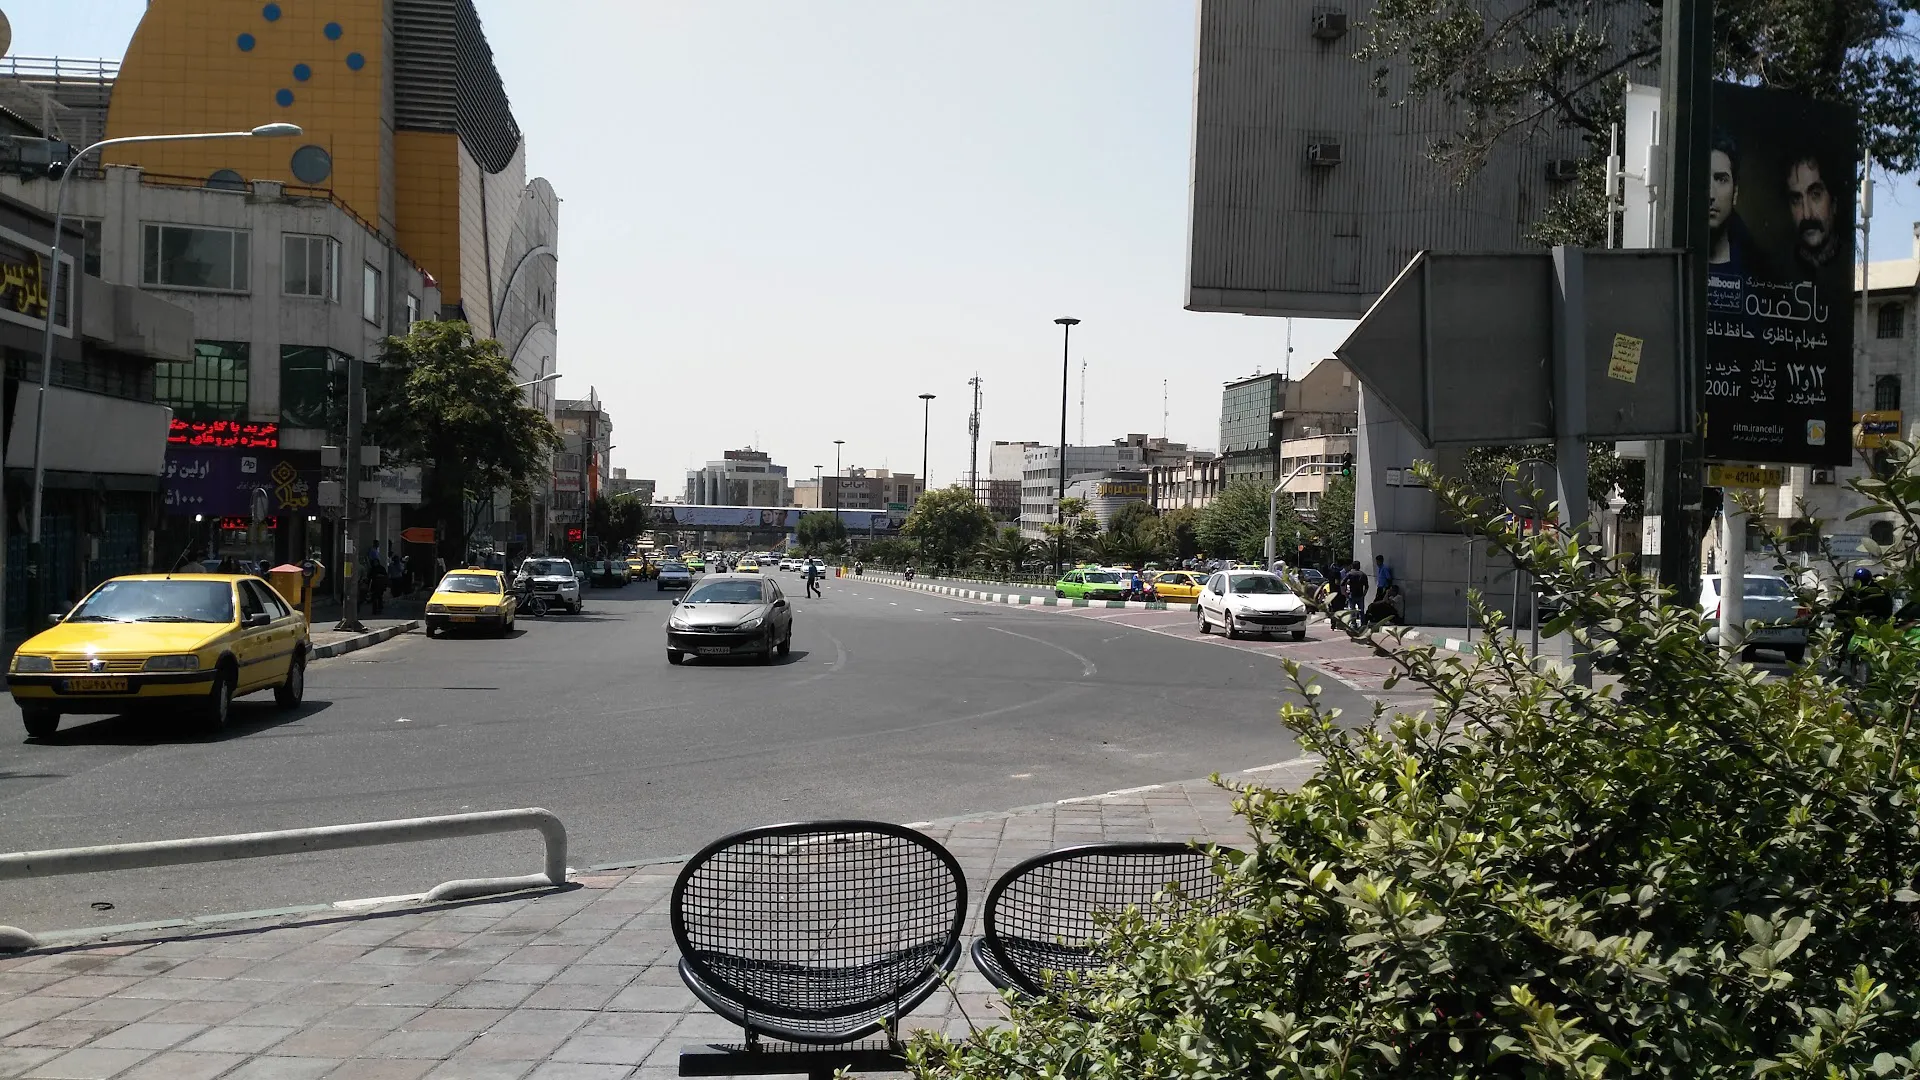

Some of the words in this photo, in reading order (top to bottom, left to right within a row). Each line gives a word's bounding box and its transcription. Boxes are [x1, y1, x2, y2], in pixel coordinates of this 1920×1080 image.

[1745, 275, 1766, 288] بزرگ
[1766, 280, 1794, 290] کنسرت
[1713, 299, 1740, 309] کلاسیک
[1745, 280, 1829, 323] ناگفته
[1724, 321, 1755, 339] حافظ
[1762, 325, 1794, 345] ناظری
[1794, 328, 1828, 351] شهرام
[1715, 359, 1741, 375] خرید
[1750, 358, 1777, 373] تالار
[1750, 372, 1777, 388] وزارت
[1749, 387, 1775, 403] کشور
[1786, 388, 1827, 405] شهریور
[192, 420, 228, 434] کارت
[230, 421, 241, 435] با
[243, 422, 277, 436] خرید
[1732, 422, 1785, 434] ritm.irancell.ir
[189, 432, 239, 447] نیروهای
[240, 435, 277, 448] ویژه
[179, 459, 210, 480] اولین
